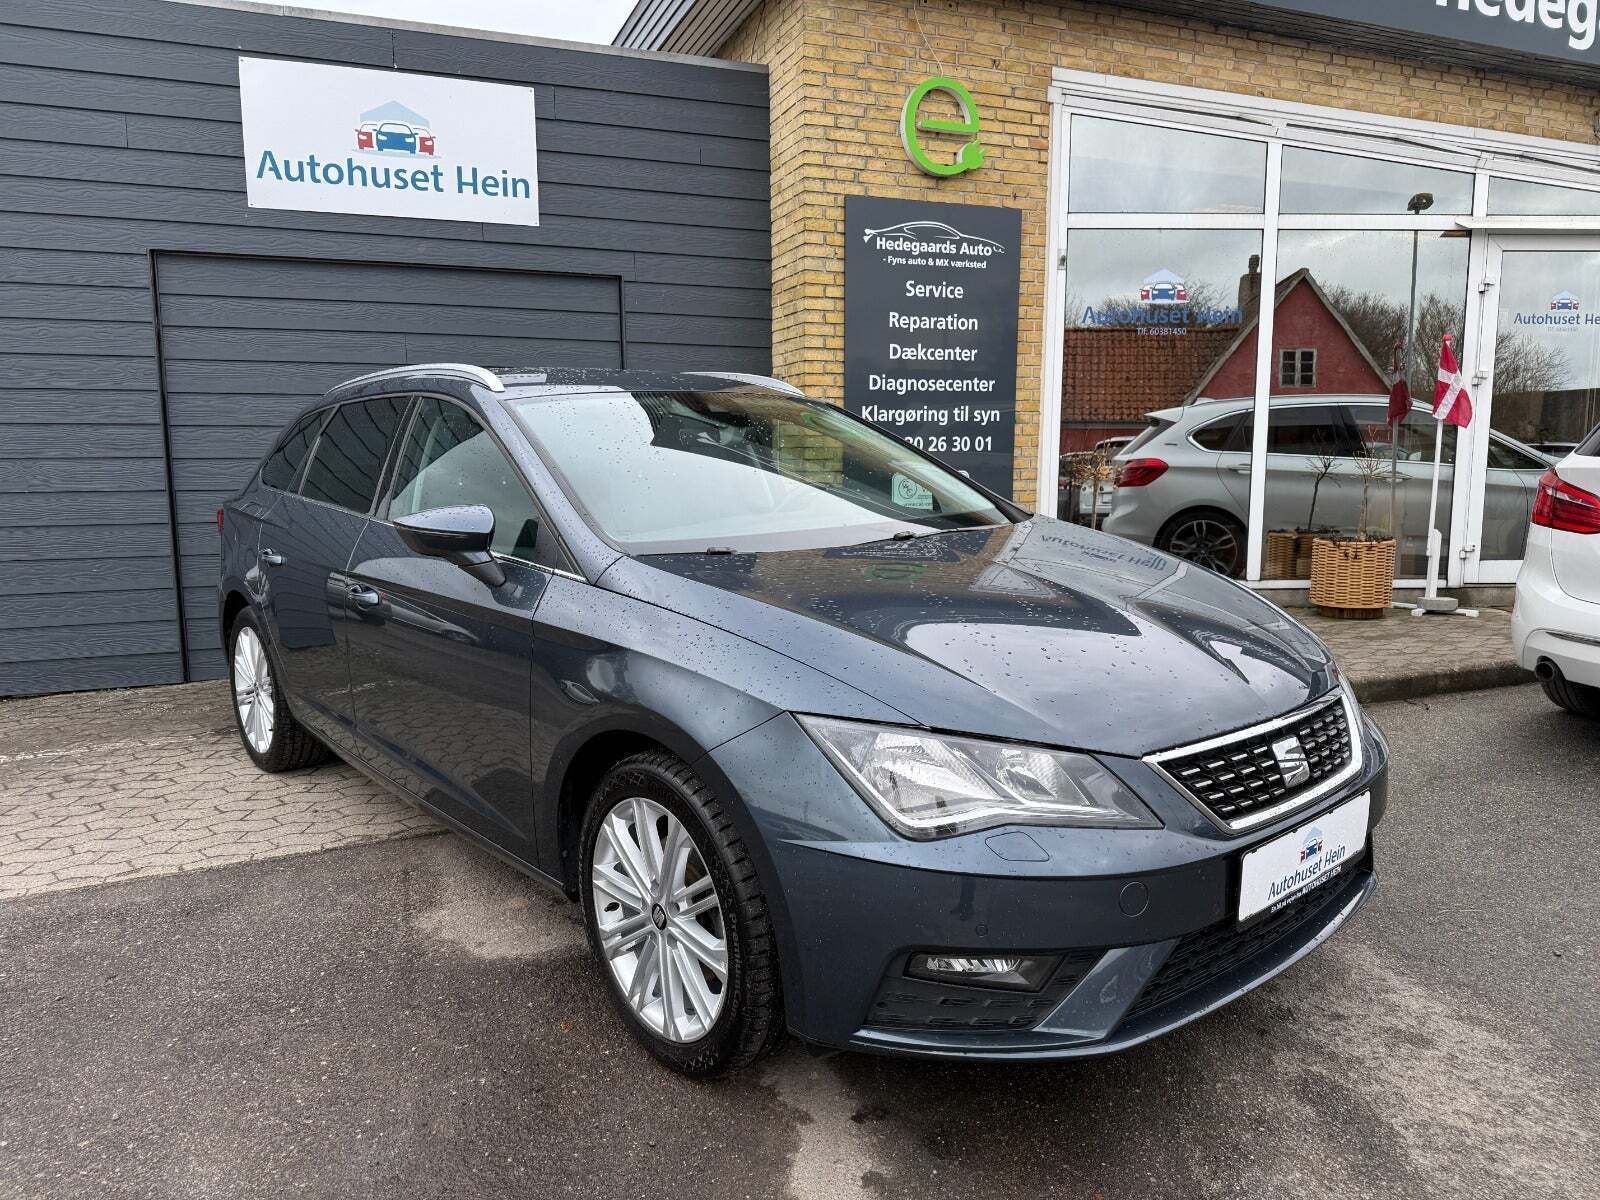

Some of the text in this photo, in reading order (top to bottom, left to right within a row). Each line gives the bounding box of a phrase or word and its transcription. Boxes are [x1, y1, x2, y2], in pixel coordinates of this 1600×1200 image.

[256, 150, 531, 199] Autohuset Hein
[876, 236, 993, 257] Hedegaards Auto
[887, 256, 907, 266] Fyns
[907, 258, 926, 266] auto
[927, 257, 935, 266] &
[935, 258, 949, 267] MX
[950, 260, 987, 269] værksted
[905, 280, 964, 299] Service
[888, 311, 979, 333] Reparation
[1081, 304, 1191, 326] Autohuset
[1513, 312, 1581, 325] Autohuset
[889, 343, 978, 362] Dækcenter
[868, 374, 996, 396] Diagnosecenter
[861, 405, 1001, 426] Klargøring til syn
[928, 435, 947, 452] 26
[951, 436, 971, 452] 30
[974, 435, 992, 452] 01
[1268, 844, 1346, 901] Autohuset Hein
